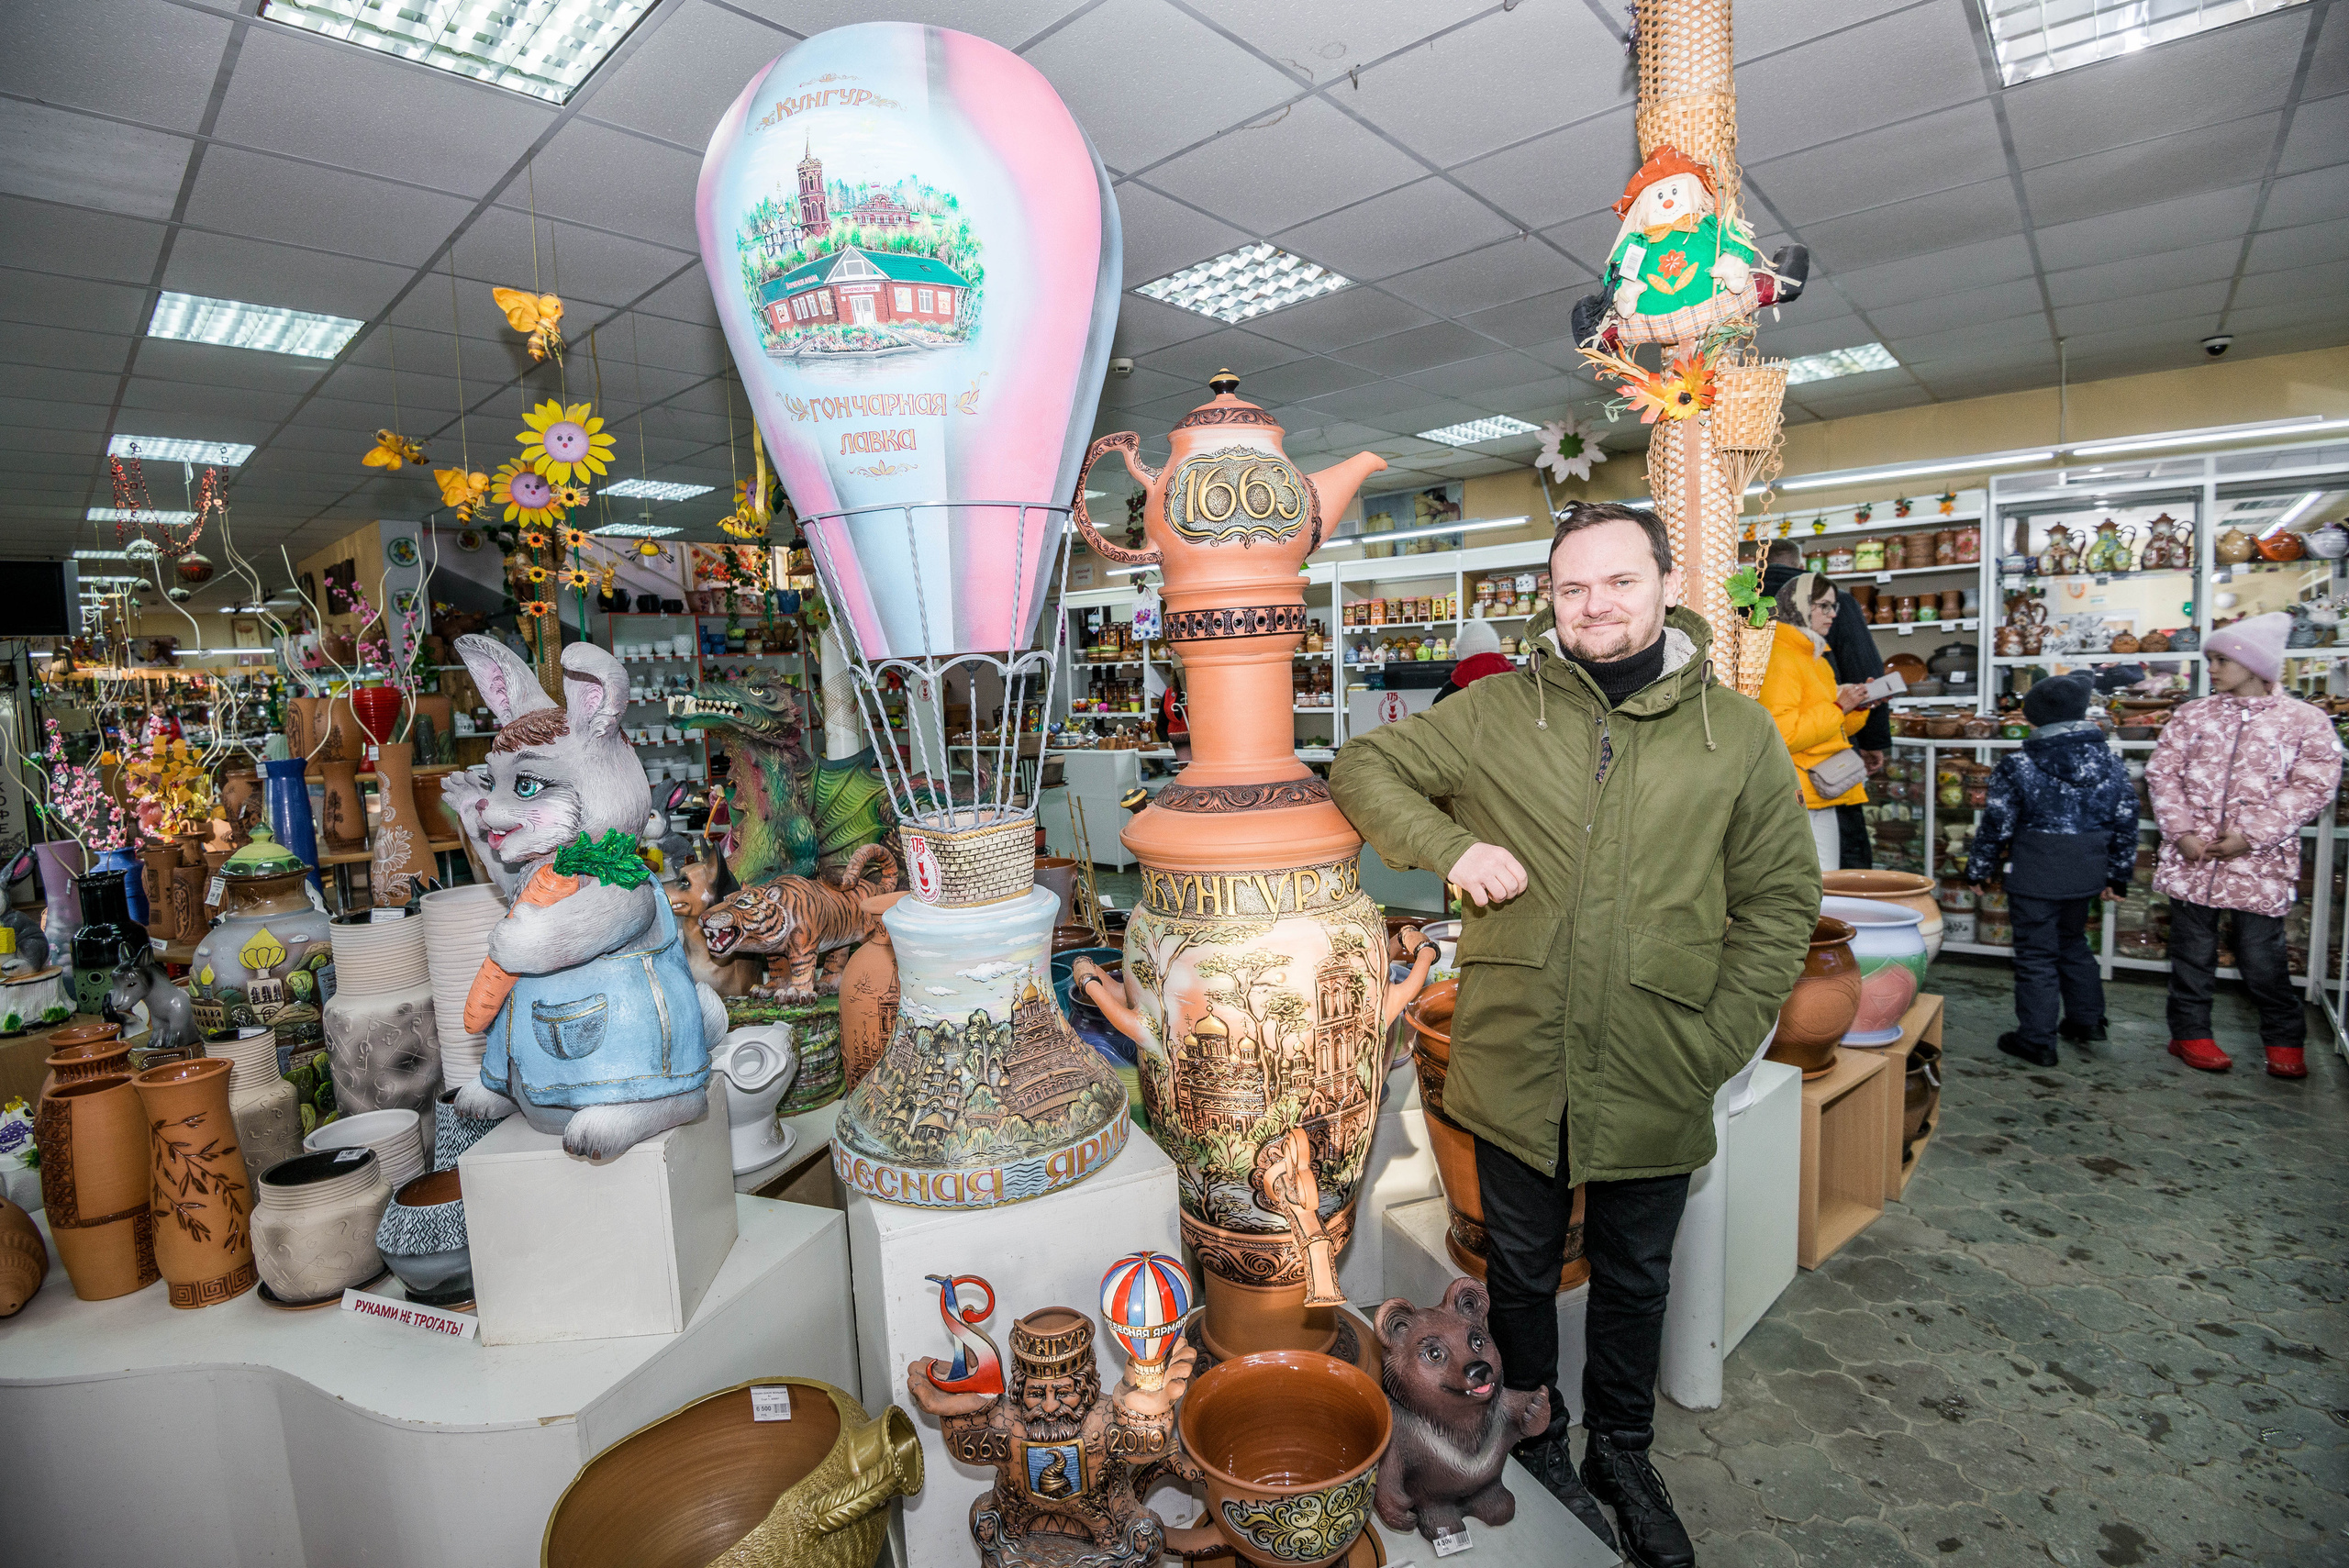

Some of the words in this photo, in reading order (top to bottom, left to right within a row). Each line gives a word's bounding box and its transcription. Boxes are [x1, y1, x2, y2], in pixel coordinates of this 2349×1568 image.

[776, 88, 873, 122] КУНГУР
[1181, 466, 1301, 523] 1663
[1386, 692, 1398, 701] 175
[910, 837, 925, 854] 175
[1150, 869, 1321, 923] КУНГУР
[1045, 1097, 1130, 1187] ЯРМА
[354, 1299, 399, 1320] РУКАМИ
[399, 1309, 413, 1323] НЕ
[414, 1313, 464, 1336] ТРОГАТЬ!
[1104, 1316, 1150, 1338] НЕБЕСНАЯ
[1152, 1310, 1191, 1338] ЯРМАРК
[1013, 1326, 1086, 1356] КУНГУР
[953, 1432, 1008, 1459] 1663
[1109, 1429, 1164, 1452] 2019
